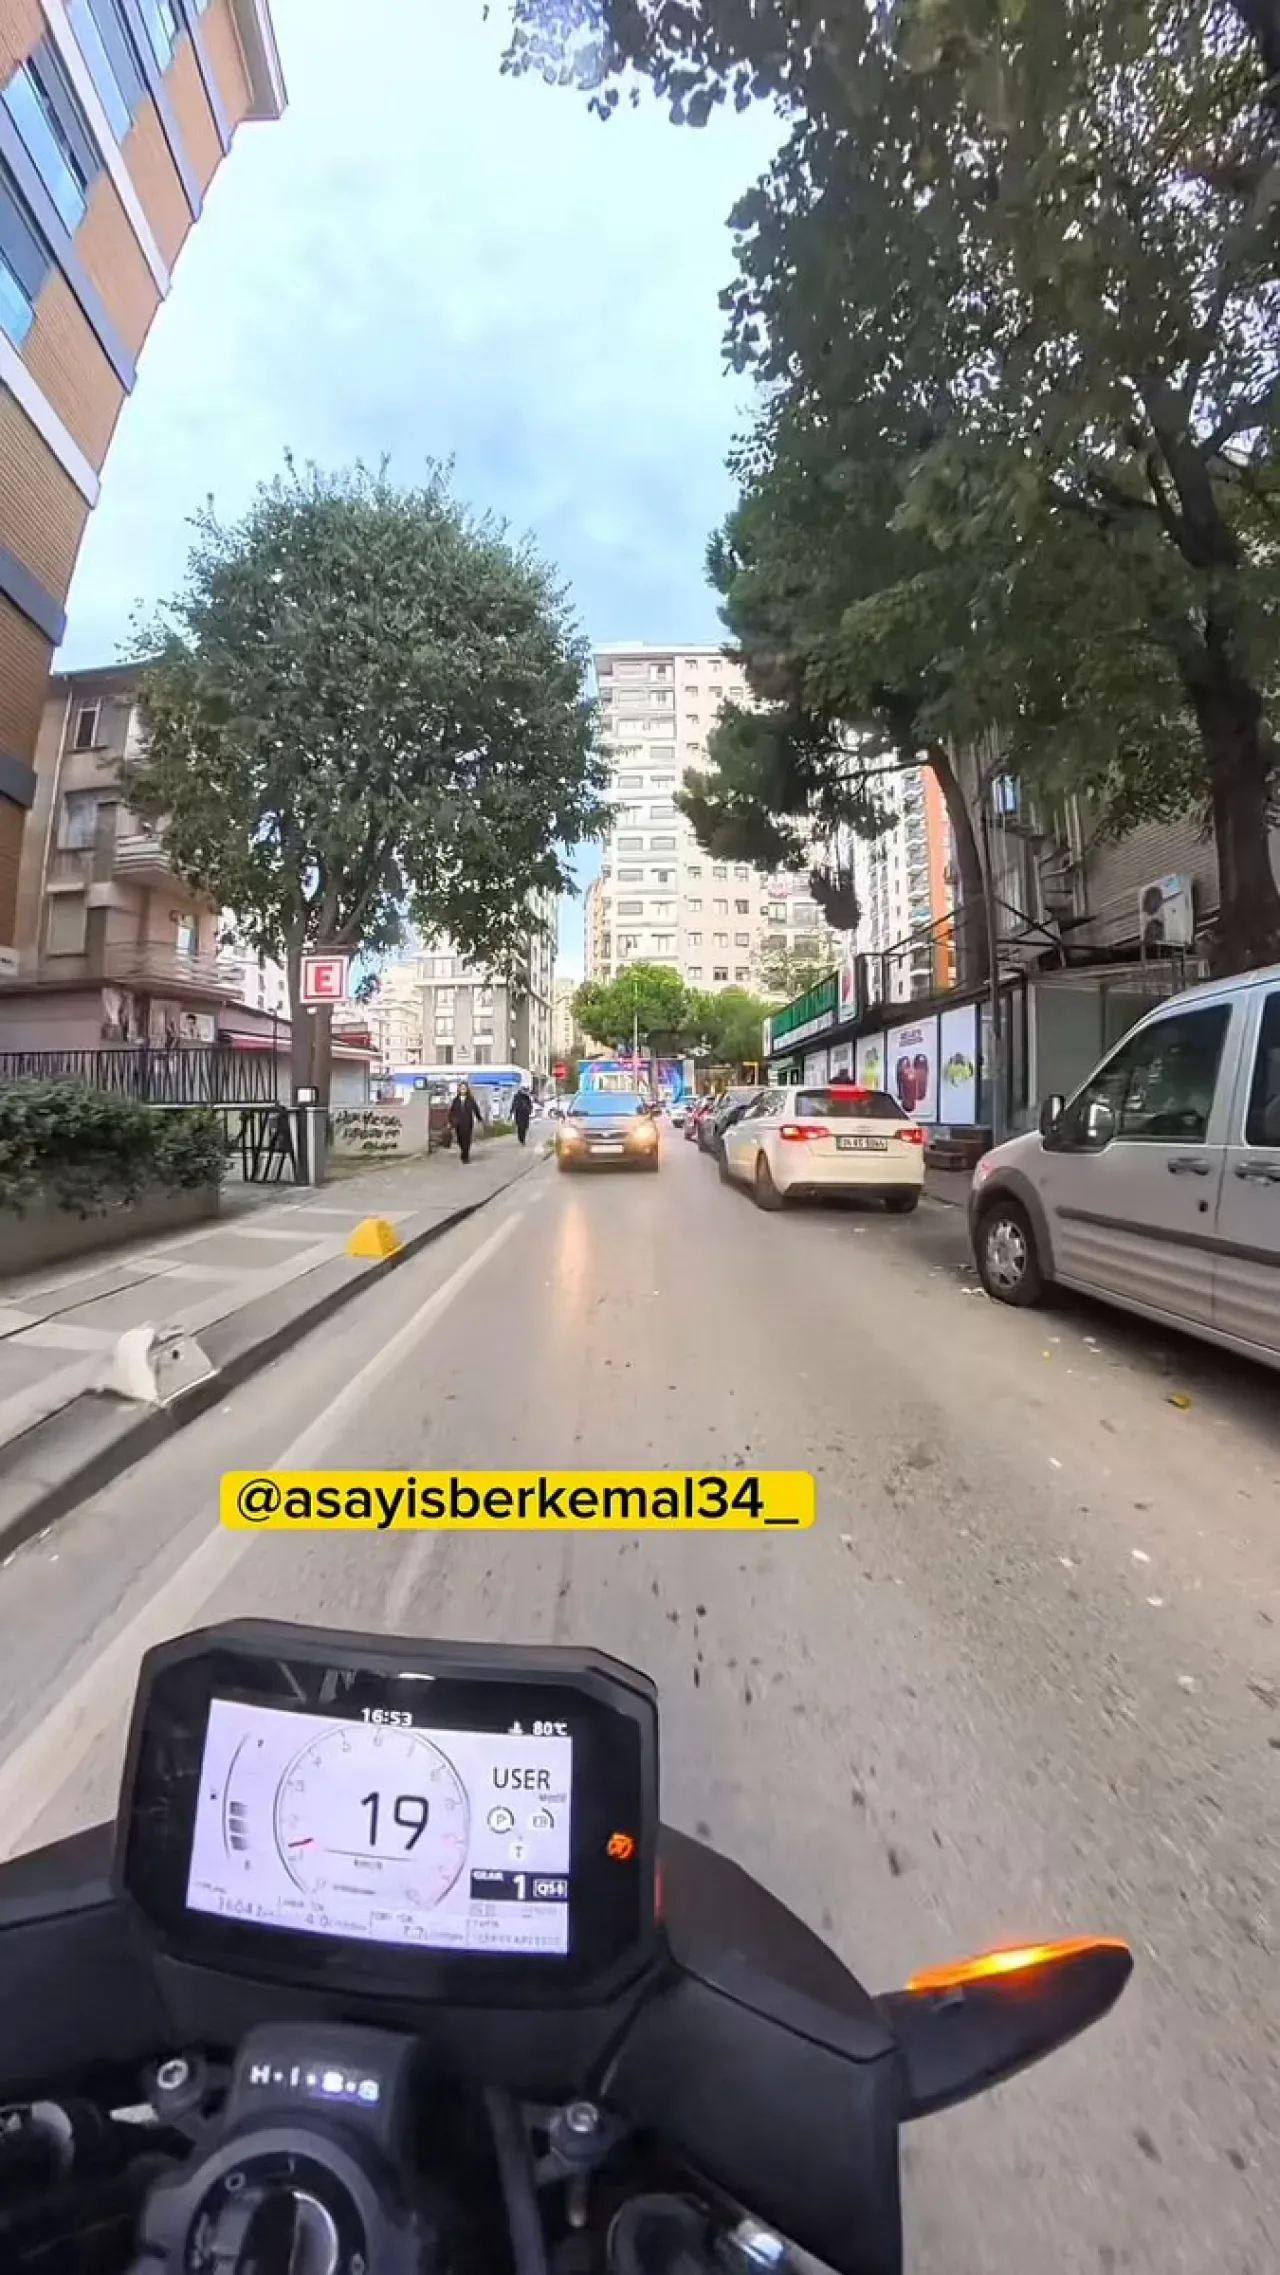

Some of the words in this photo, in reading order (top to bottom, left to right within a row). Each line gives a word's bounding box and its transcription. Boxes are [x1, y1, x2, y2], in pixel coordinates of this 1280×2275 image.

[314, 965, 334, 993] E
[361, 1707, 413, 1726] 16:53
[492, 1766, 551, 1790] USER
[360, 1790, 430, 1851] 19
[513, 1873, 527, 1900] 1
